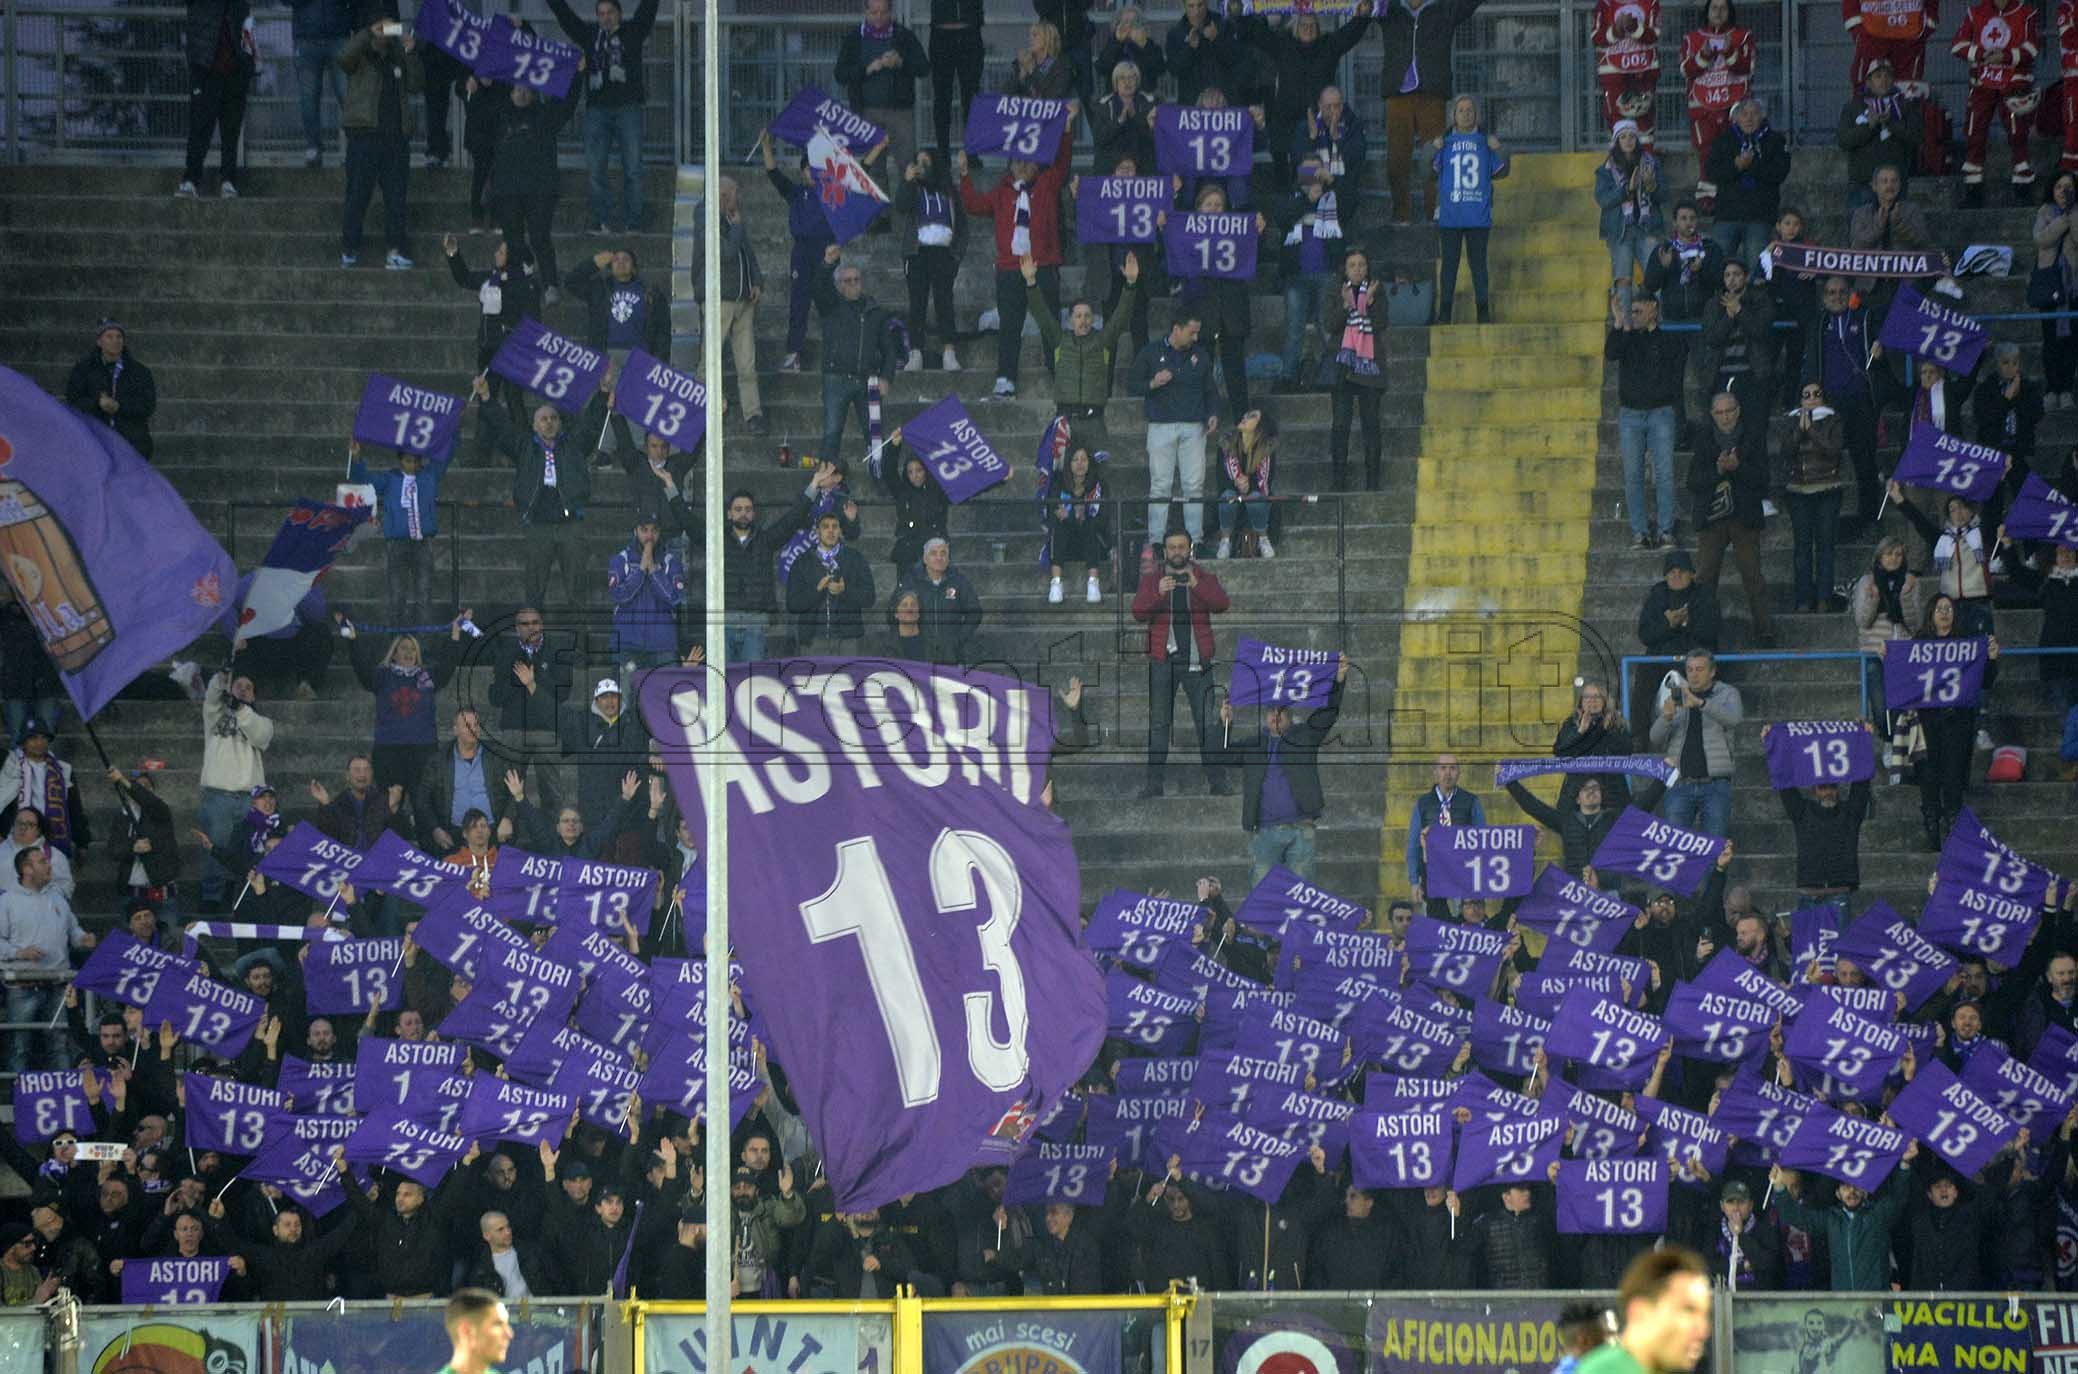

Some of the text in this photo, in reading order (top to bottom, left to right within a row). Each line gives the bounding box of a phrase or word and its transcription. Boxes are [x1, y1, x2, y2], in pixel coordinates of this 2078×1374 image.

[445, 17, 481, 60] 13
[513, 53, 554, 85] 13
[815, 99, 876, 144] ASTORI
[996, 96, 1062, 119] ASTORI
[1179, 111, 1241, 131] ASTORI
[1001, 121, 1041, 154] 13
[1188, 136, 1231, 171] 13
[1100, 179, 1164, 198] ASTORI
[1450, 153, 1480, 191] 13
[1110, 204, 1152, 237] 13
[1185, 216, 1248, 235] ASTORI
[1195, 240, 1236, 271] 13
[1804, 250, 1929, 273] FIORENTINA
[536, 332, 600, 372] ASTORI
[1919, 325, 1963, 360] 13
[529, 357, 575, 398] 13
[388, 384, 455, 414] ASTORI
[644, 395, 687, 436] 13
[394, 412, 434, 449] 13
[949, 418, 1002, 472] ASTORI
[929, 440, 973, 480] 13
[1935, 435, 2001, 463] ASTORI
[1935, 458, 1980, 489] 13
[1909, 642, 1977, 663] ASTORI
[1268, 669, 1311, 701] 13
[1918, 668, 1961, 702] 13
[670, 671, 1032, 817] ASTORI
[1804, 740, 1849, 777] 13
[1455, 829, 1523, 849] ASTORI
[1642, 820, 1714, 856] ASTORI
[393, 868, 443, 897] 13
[579, 864, 648, 888] ASTORI
[1464, 856, 1510, 892] 13
[1637, 849, 1685, 881] 13
[1981, 851, 2028, 893] 13
[585, 891, 630, 927] 13
[1286, 881, 1358, 920] ASTORI
[1559, 880, 1628, 918] ASTORI
[1959, 888, 2032, 924] ASTORI
[1555, 909, 1599, 946] 13
[1961, 917, 2006, 953] 13
[331, 939, 399, 965] ASTORI
[1119, 930, 1165, 963] 13
[1326, 947, 1393, 968] ASTORI
[1885, 921, 1950, 970] ASTORI
[503, 949, 573, 988] ASTORI
[799, 825, 1029, 1108] 13
[1430, 951, 1475, 985] 13
[1870, 947, 1919, 989] 13
[115, 967, 161, 1004] 13
[185, 975, 253, 1014] ASTORI
[343, 967, 389, 1006] 13
[1128, 984, 1197, 1016] ASTORI
[1734, 969, 1804, 1016] ASTORI
[184, 1005, 231, 1045] 13
[1270, 1010, 1339, 1042] ASTORI
[1591, 999, 1662, 1042] ASTORI
[1699, 993, 1771, 1025] ASTORI
[1703, 1022, 1749, 1057] 13
[1827, 1007, 1900, 1052] ASTORI
[384, 1044, 455, 1064] ASTORI
[1382, 1035, 1431, 1069] 13
[1589, 1030, 1636, 1070] 13
[1822, 1039, 1872, 1076] 13
[1226, 1056, 1300, 1084] ASTORI
[588, 1088, 634, 1124] 13
[1116, 1098, 1186, 1119] ASTORI
[1942, 1082, 2011, 1136] ASTORI
[219, 1109, 264, 1149] 13
[1226, 1121, 1297, 1158] ASTORI
[1376, 1114, 1441, 1137] ASTORI
[1488, 1117, 1559, 1146] ASTORI
[1756, 1107, 1802, 1146] 13
[1829, 1115, 1903, 1151] ASTORI
[1928, 1109, 1978, 1157] 13
[384, 1142, 434, 1169] 13
[1223, 1151, 1270, 1186] 13
[1389, 1141, 1432, 1180] 13
[1585, 1160, 1657, 1182] ASTORI
[1825, 1143, 1872, 1178] 13
[1044, 1164, 1087, 1197] 13
[1596, 1188, 1644, 1228] 13
[150, 1261, 219, 1282] ASTORI
[1893, 1301, 2029, 1332] VACILLO
[965, 1320, 1077, 1352] mai scesi
[1190, 1341, 1208, 1359] 17
[1892, 1342, 1940, 1369] MA
[1954, 1344, 2027, 1374] NON
